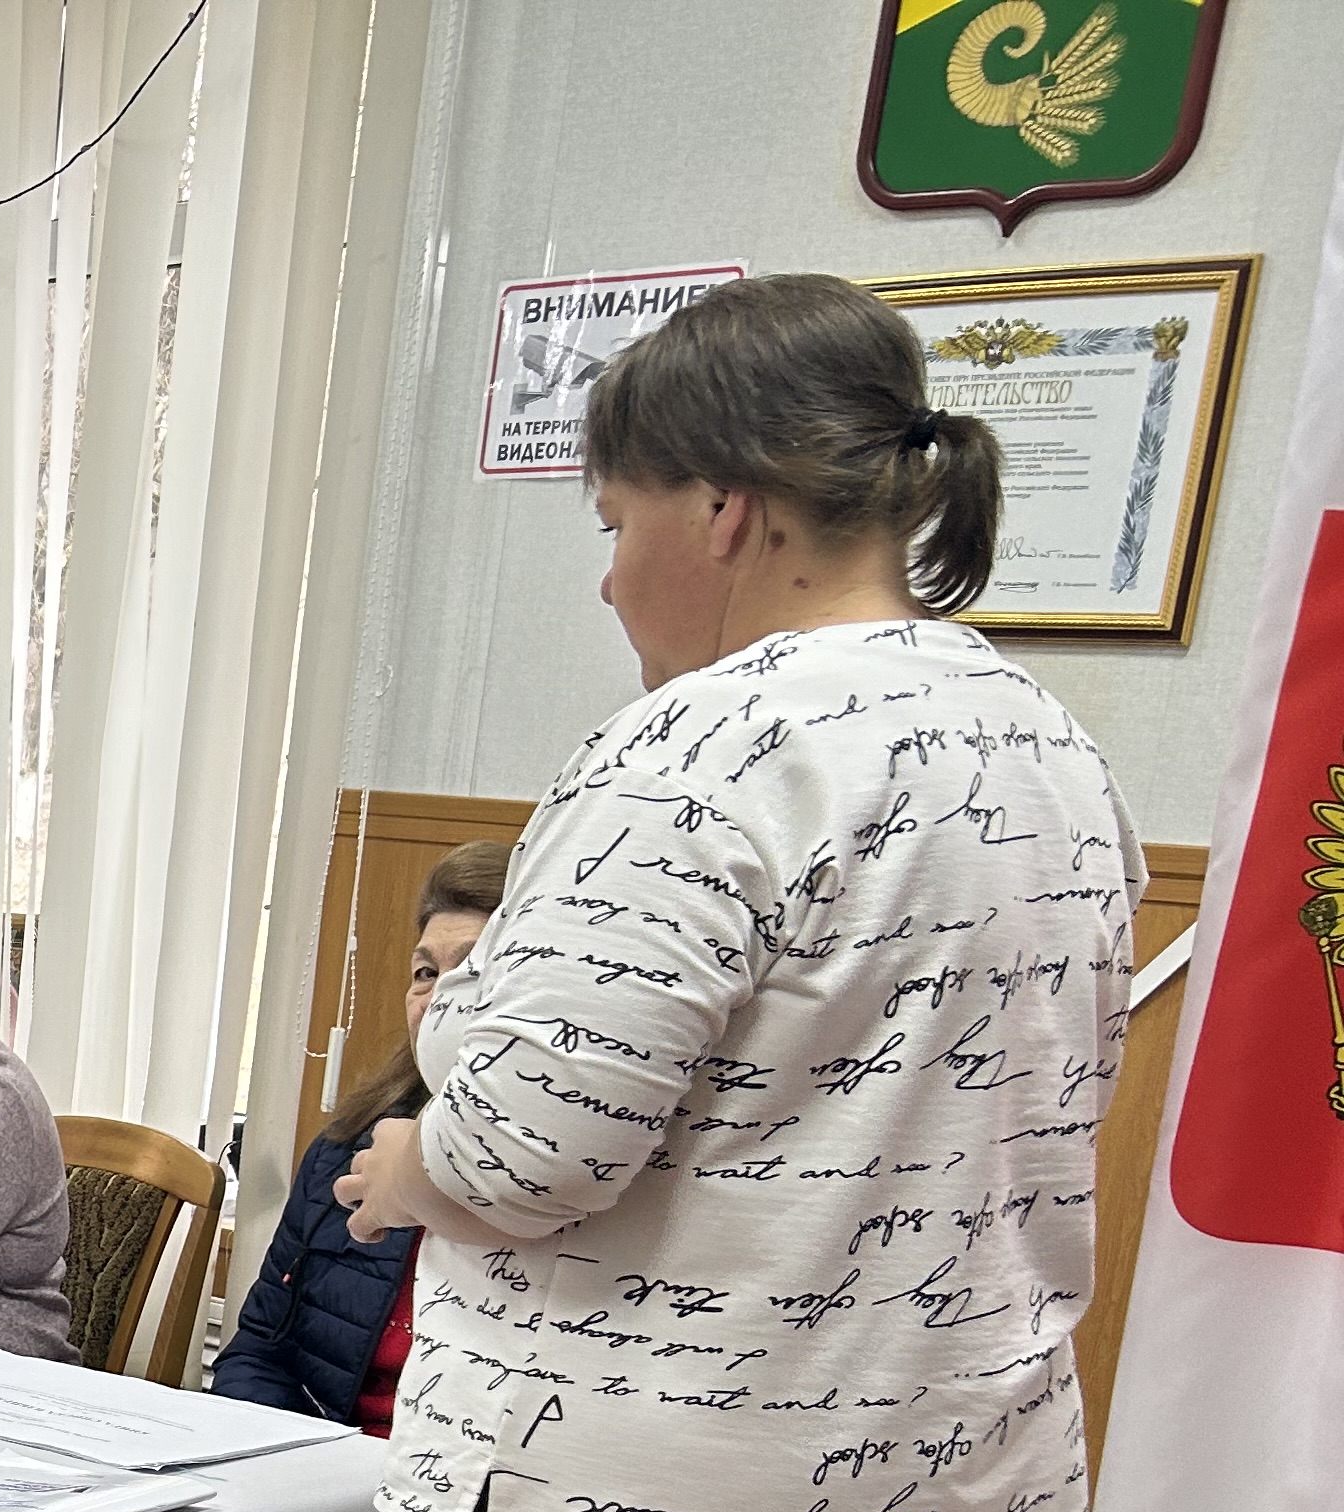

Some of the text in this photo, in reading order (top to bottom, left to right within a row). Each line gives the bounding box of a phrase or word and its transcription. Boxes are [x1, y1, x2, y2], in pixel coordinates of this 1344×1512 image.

[523, 284, 718, 324] ВНИМАНИЕ
[929, 379, 1073, 408] ИДЕТЕЛЬСТВО
[502, 419, 585, 437] НА ТЕРРИТ
